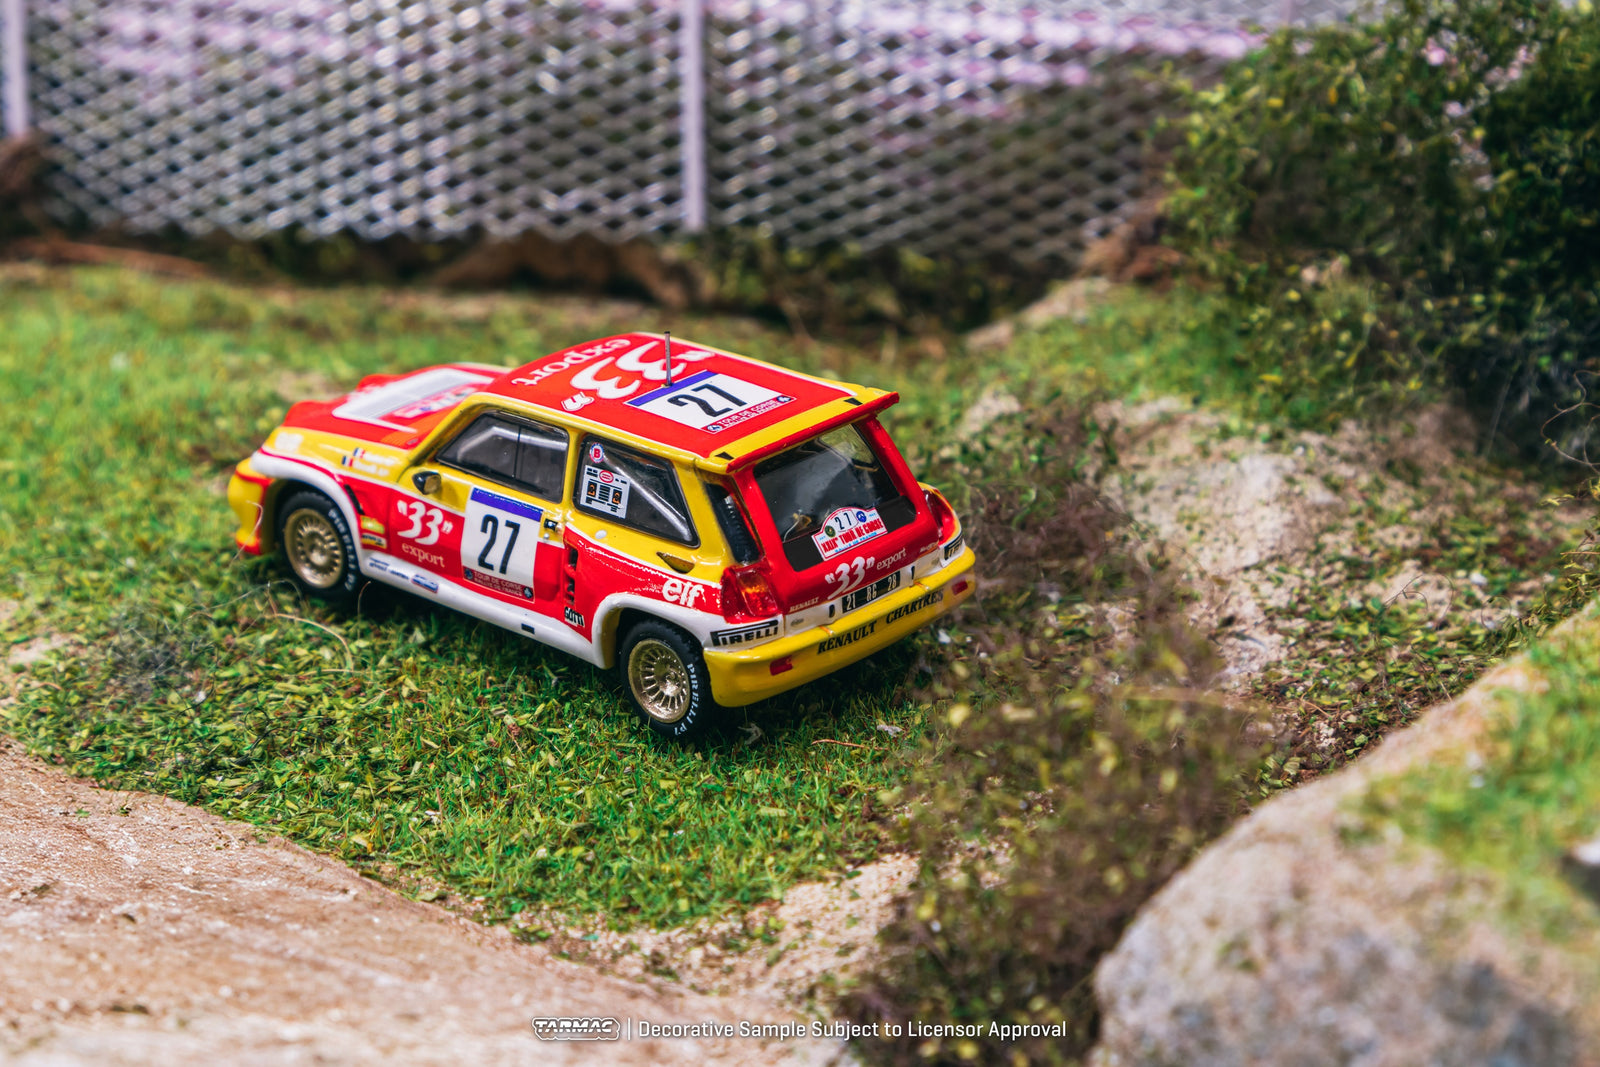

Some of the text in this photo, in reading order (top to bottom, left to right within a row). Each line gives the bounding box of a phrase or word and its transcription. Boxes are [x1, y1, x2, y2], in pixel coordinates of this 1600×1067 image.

[511, 339, 631, 386] export
[667, 383, 747, 417] 27
[593, 447, 601, 459] B
[478, 514, 520, 575] 27
[839, 529, 857, 545] TOUR
[854, 526, 865, 537] DE
[862, 518, 884, 534] CORSE
[402, 542, 445, 568] export
[876, 547, 907, 570] export
[474, 571, 523, 591] TOUR DE CORSE
[662, 579, 702, 607] elf
[846, 593, 856, 611] 21
[888, 573, 897, 591] 28
[789, 596, 820, 612] RENAULT
[710, 619, 779, 647] PIRELLI
[817, 588, 944, 655] RENAULT CHARTRES
[687, 663, 700, 724] PIRELLI
